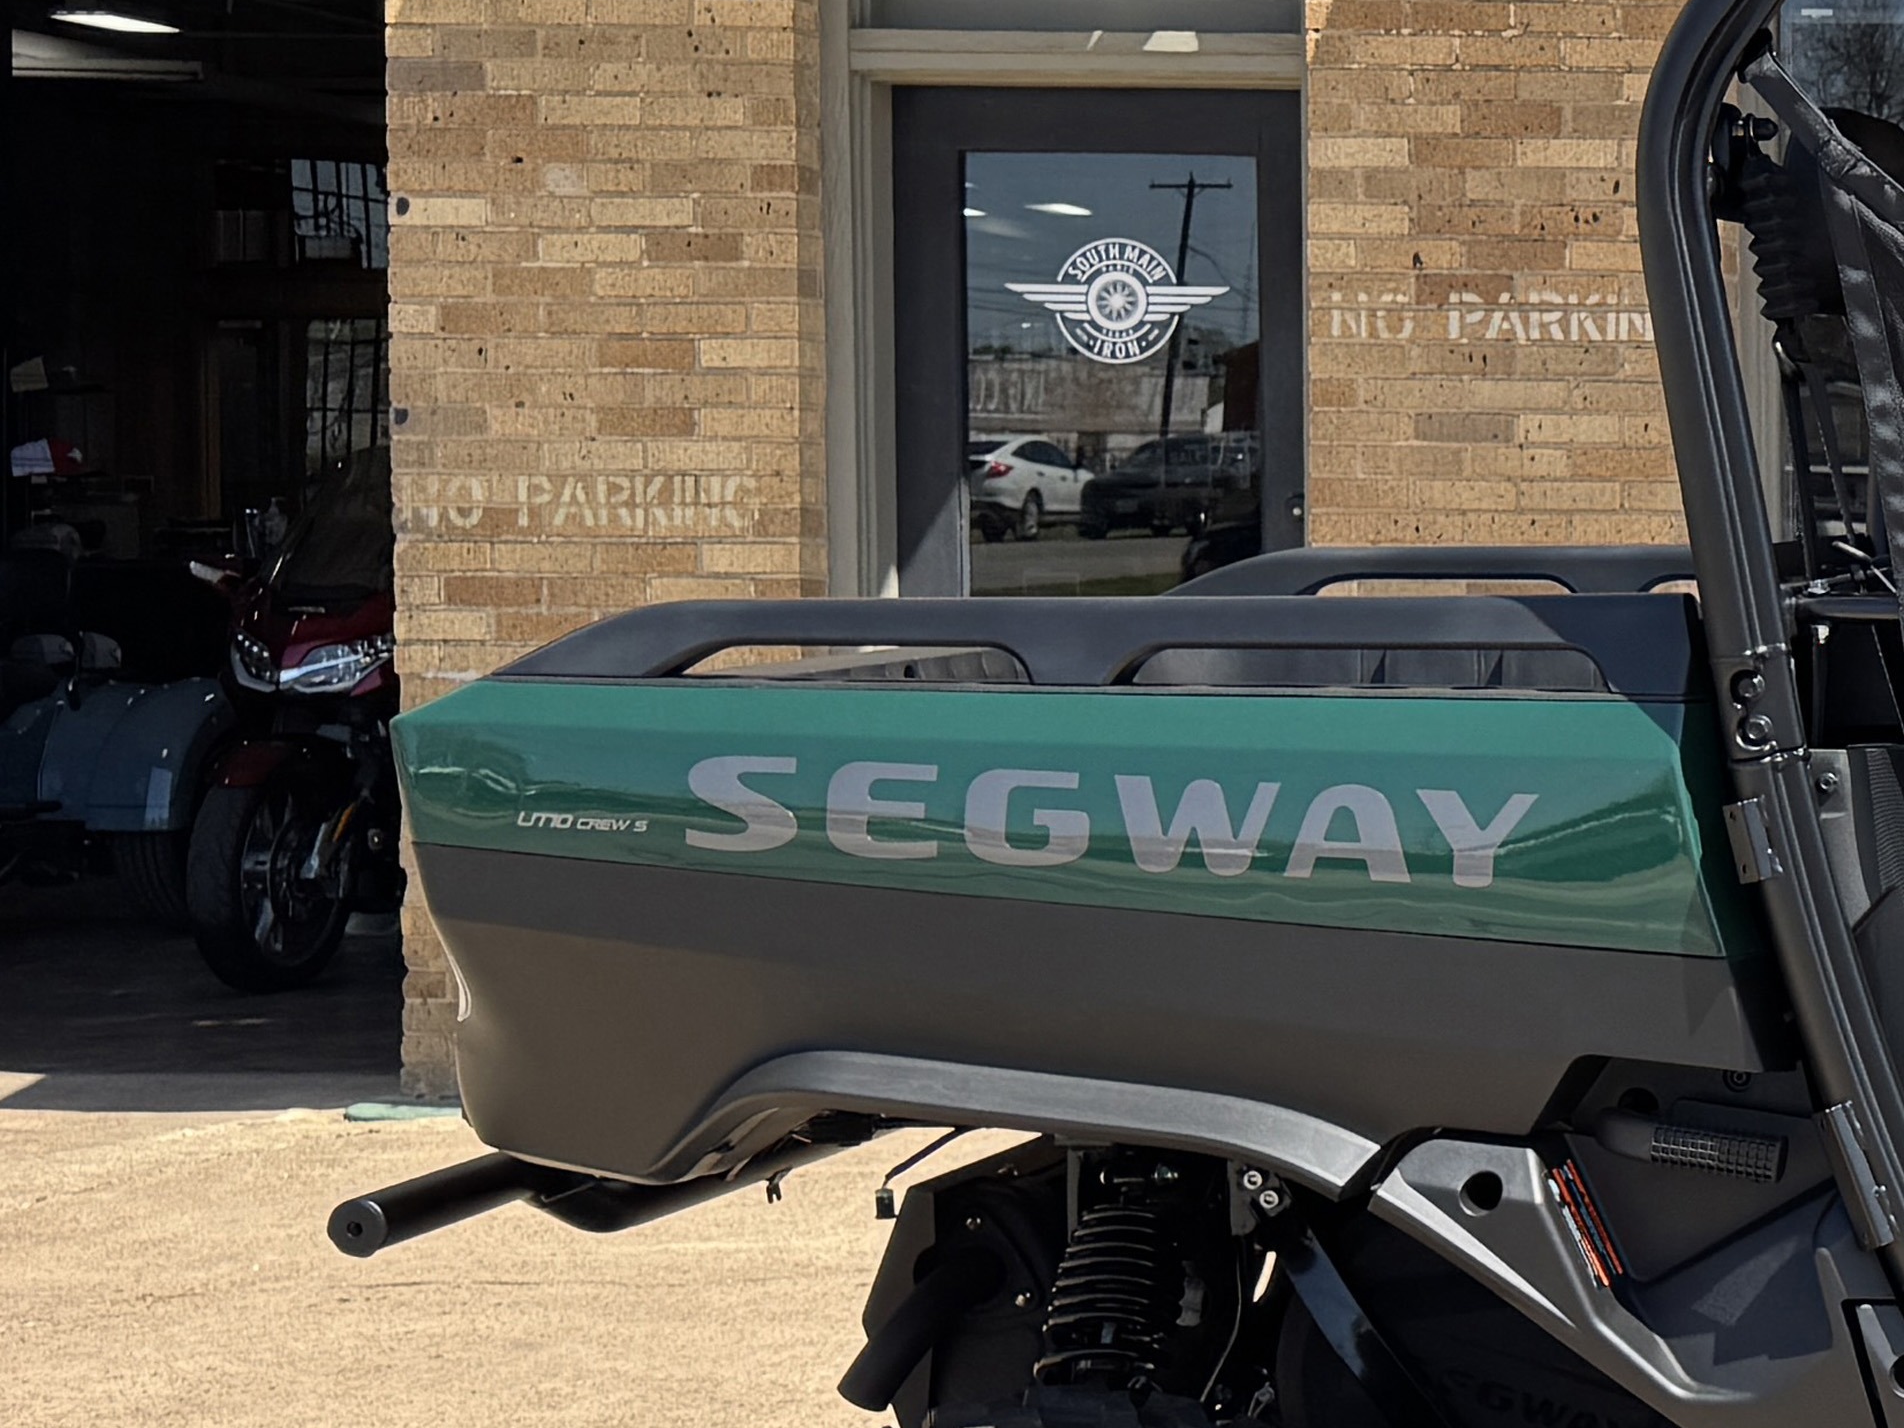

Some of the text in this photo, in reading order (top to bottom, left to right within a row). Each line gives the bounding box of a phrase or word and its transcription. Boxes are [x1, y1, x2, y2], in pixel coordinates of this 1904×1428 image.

[1067, 243, 1167, 280] SOUTH MAIN
[1330, 290, 1655, 341] NO PARKIN
[1093, 340, 1141, 359] IRON
[576, 818, 631, 831] CREW
[633, 819, 649, 832] S
[684, 754, 1539, 889] SEGWAY
